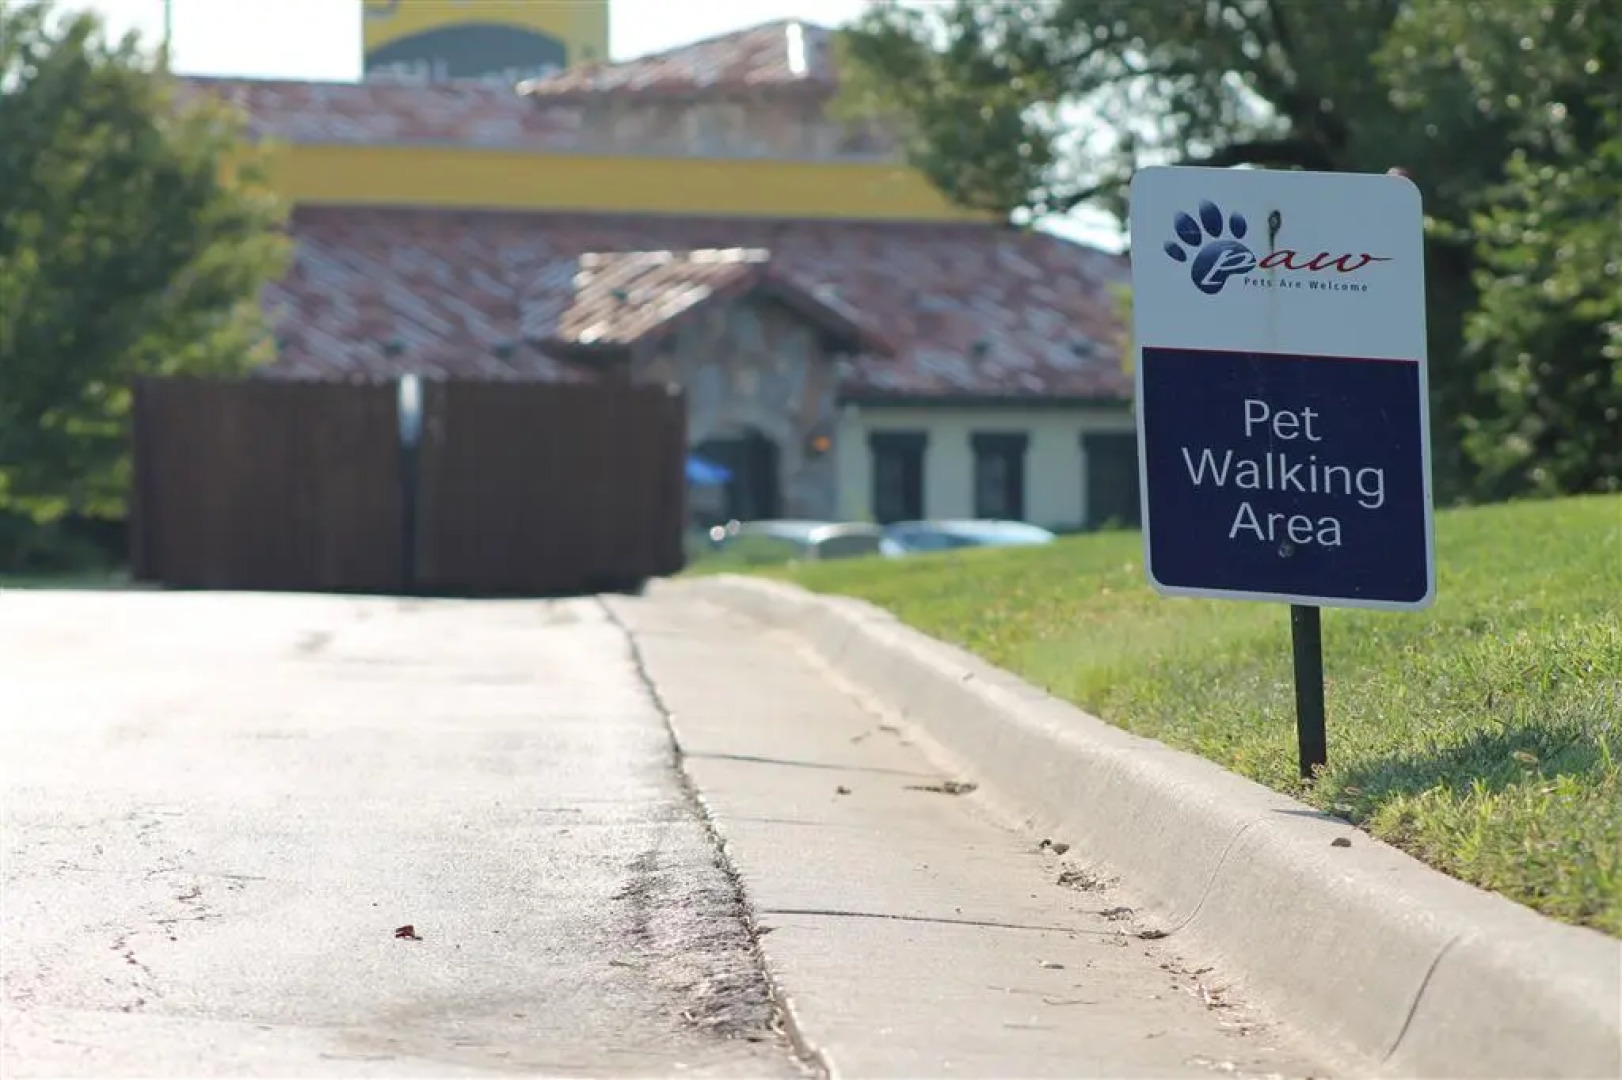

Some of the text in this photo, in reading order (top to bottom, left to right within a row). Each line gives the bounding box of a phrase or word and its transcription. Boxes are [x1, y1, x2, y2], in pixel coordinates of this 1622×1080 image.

[1244, 277, 1368, 292] Pets Are Welcome
[1244, 399, 1322, 441] Pet
[1182, 447, 1385, 509] Walking
[1228, 501, 1342, 546] Area
